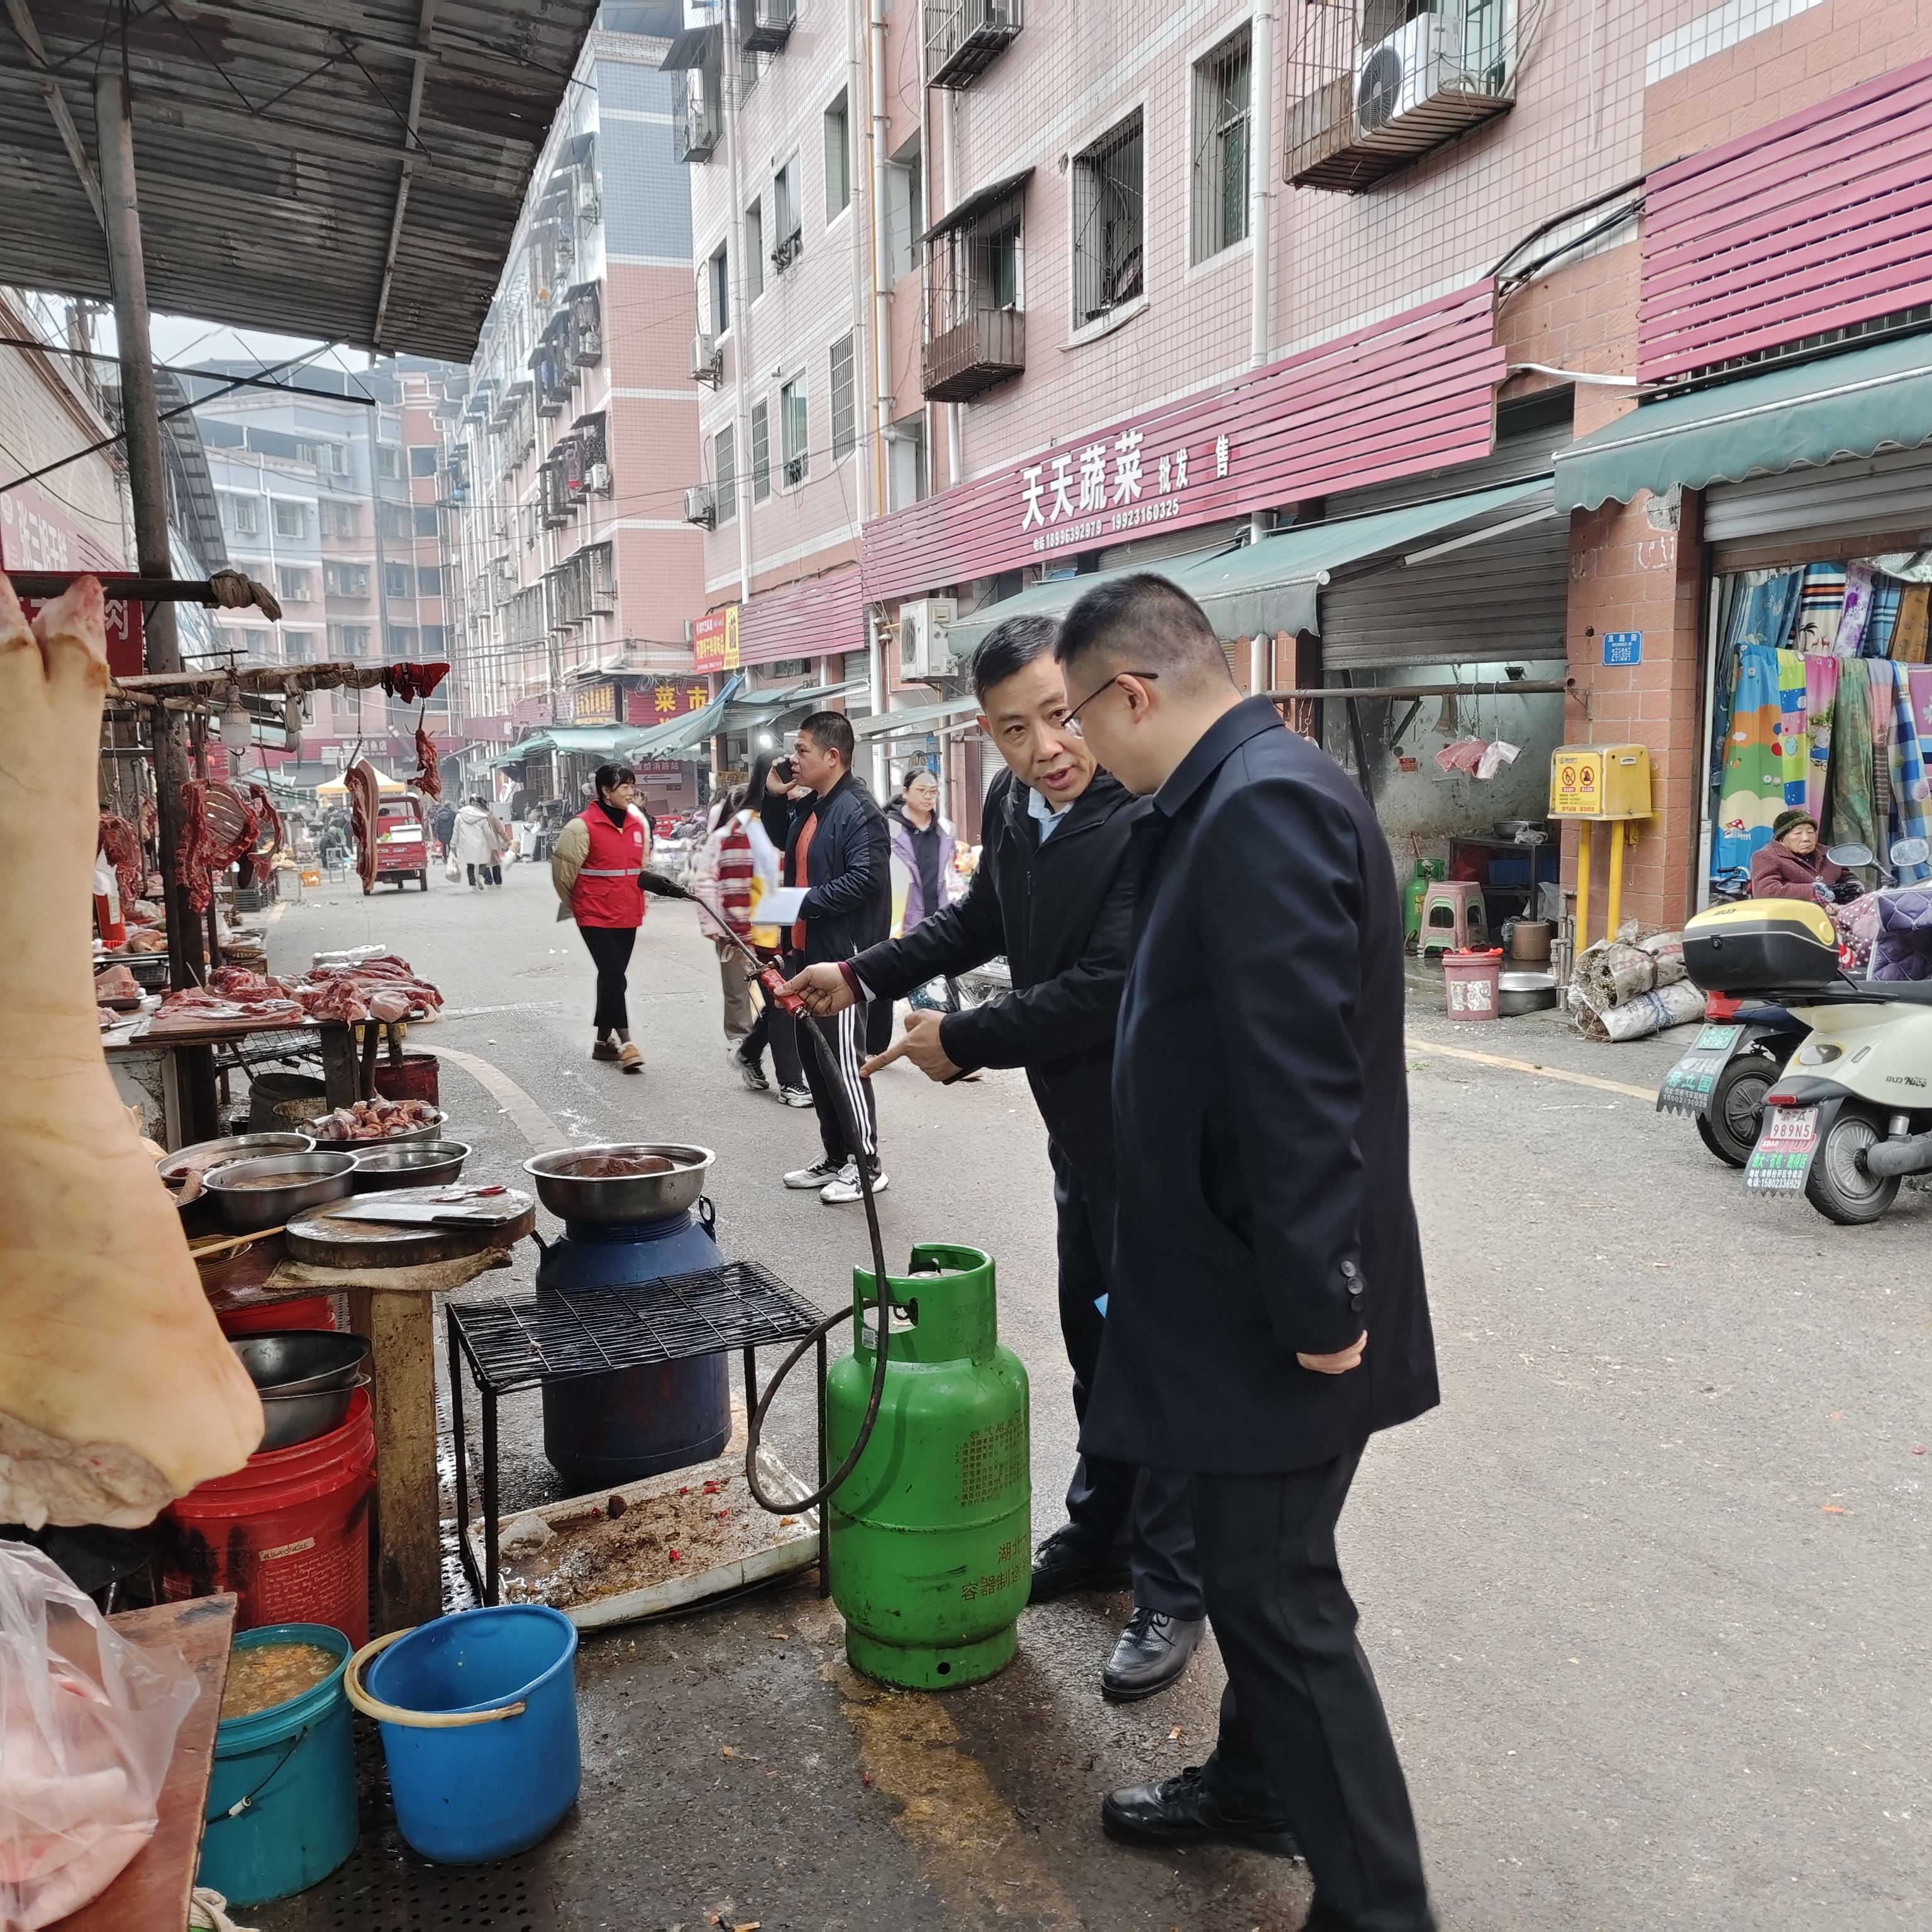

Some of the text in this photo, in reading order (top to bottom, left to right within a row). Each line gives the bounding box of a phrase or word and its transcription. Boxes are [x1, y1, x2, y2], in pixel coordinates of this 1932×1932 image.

[1021, 431, 1230, 531] 天天蔬菜 批发 售
[1111, 498, 1180, 530] 19923160325
[1773, 1124, 1811, 1137] 989N5
[1747, 1177, 1801, 1189] 电话:15802336929
